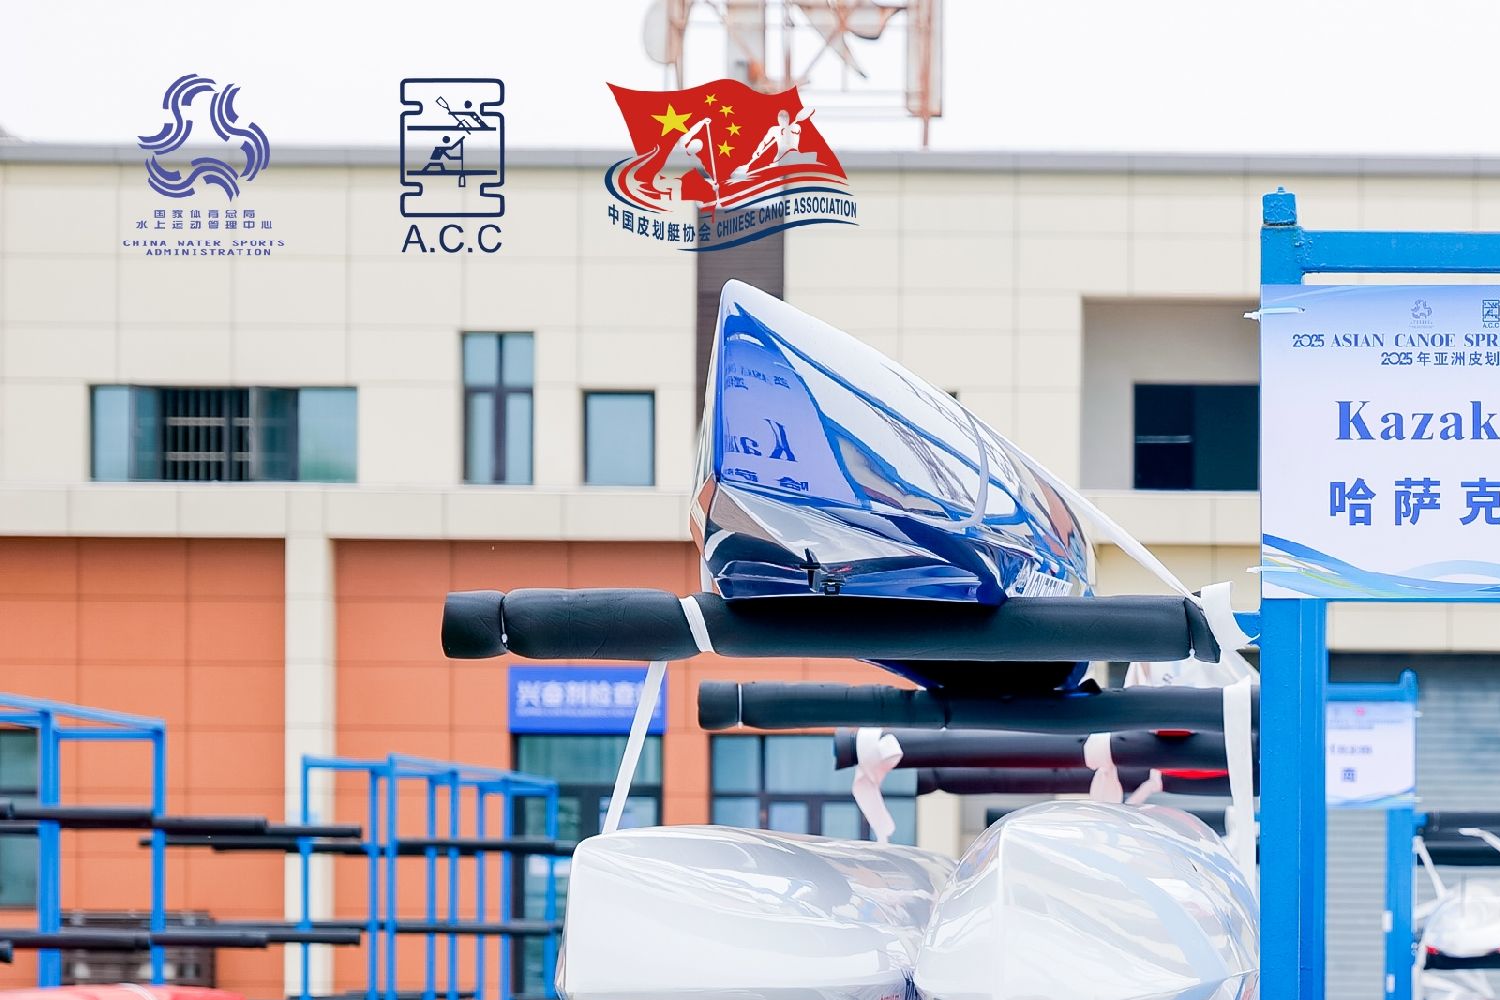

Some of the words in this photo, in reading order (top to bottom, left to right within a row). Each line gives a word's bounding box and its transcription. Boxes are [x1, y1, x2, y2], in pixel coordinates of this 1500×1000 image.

[1292, 334, 1325, 348] 2025
[1331, 333, 1385, 348] ASIAN
[1394, 332, 1456, 348] CANOE
